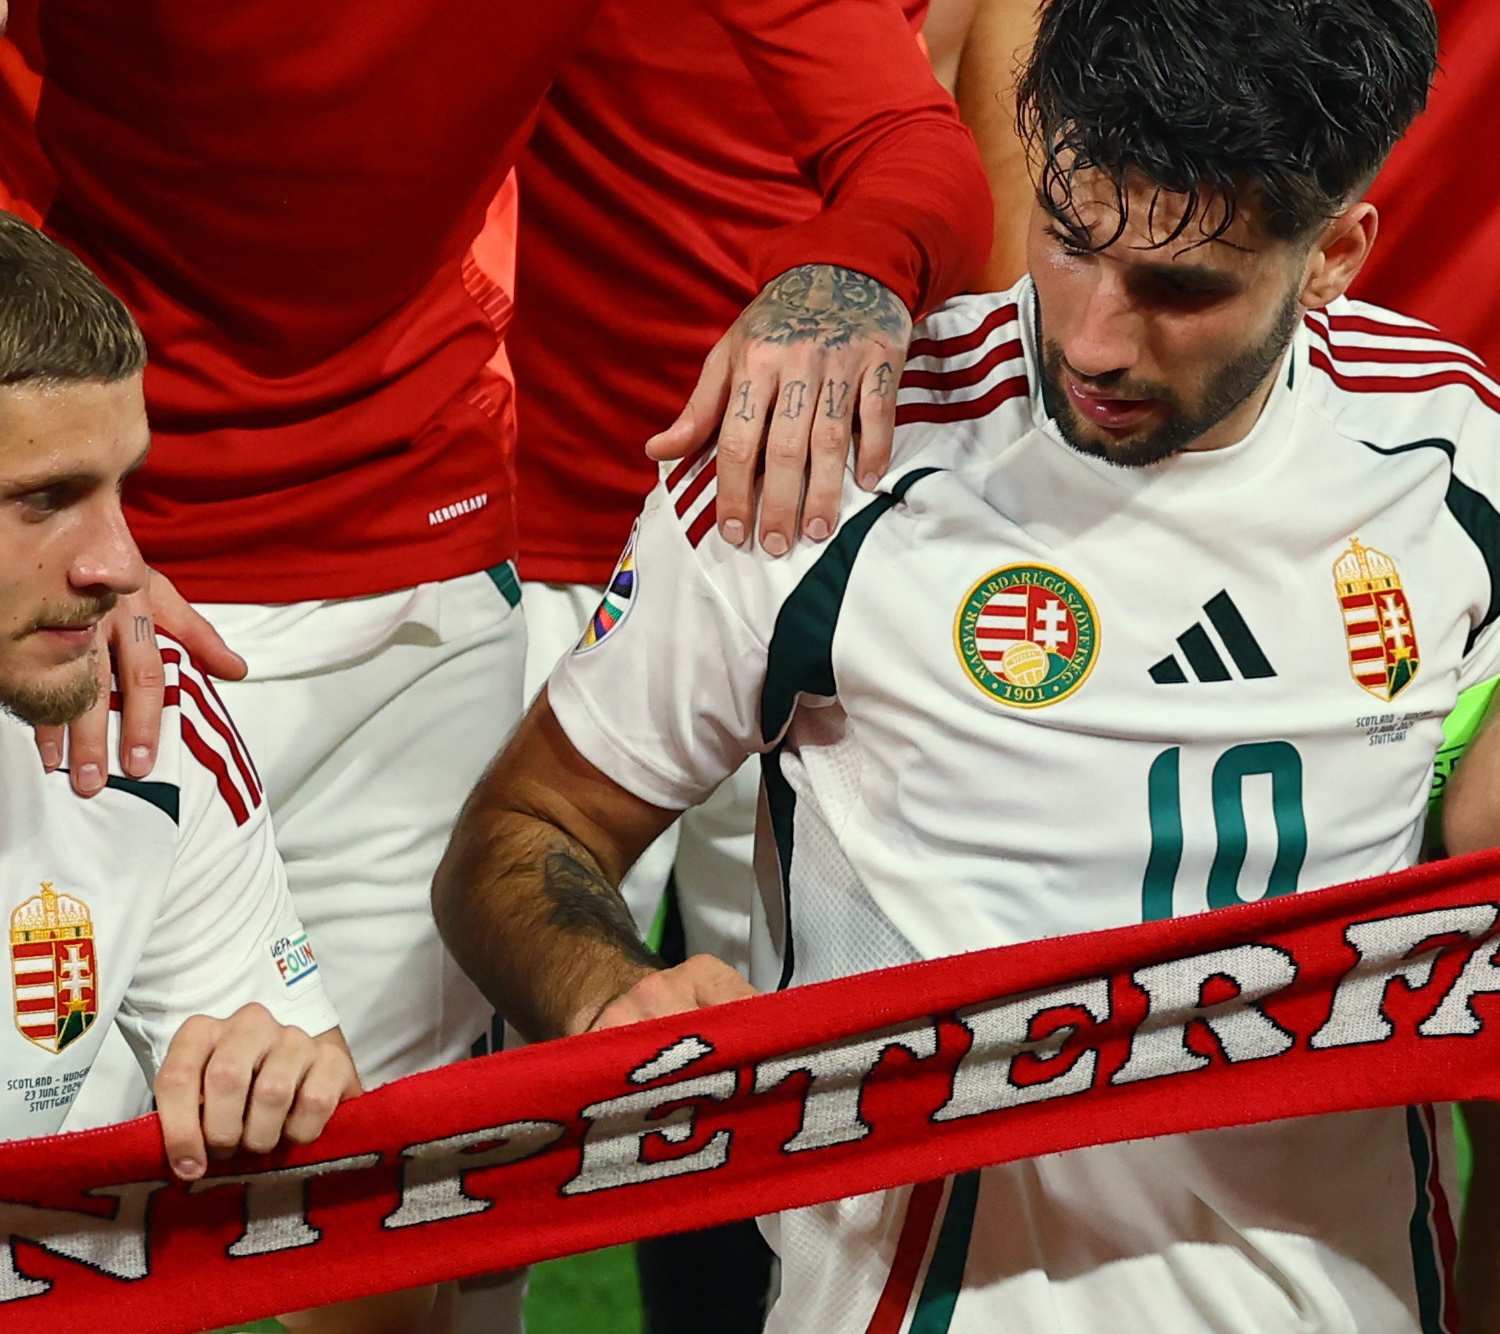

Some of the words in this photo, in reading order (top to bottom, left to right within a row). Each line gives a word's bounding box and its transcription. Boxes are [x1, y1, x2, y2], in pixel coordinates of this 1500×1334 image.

[428, 493, 488, 525] AEROREADY
[963, 611, 990, 680] MAGYAR
[1003, 685, 1046, 701] 1901
[1356, 714, 1395, 728] SCOTLAND
[1369, 731, 1407, 746] STUTTGART
[1141, 740, 1308, 923] 10
[7, 1075, 53, 1091] SCOTLAND
[24, 1090, 36, 1102] 23
[38, 1086, 60, 1100] JUNE
[29, 1093, 74, 1113] STUTTGART
